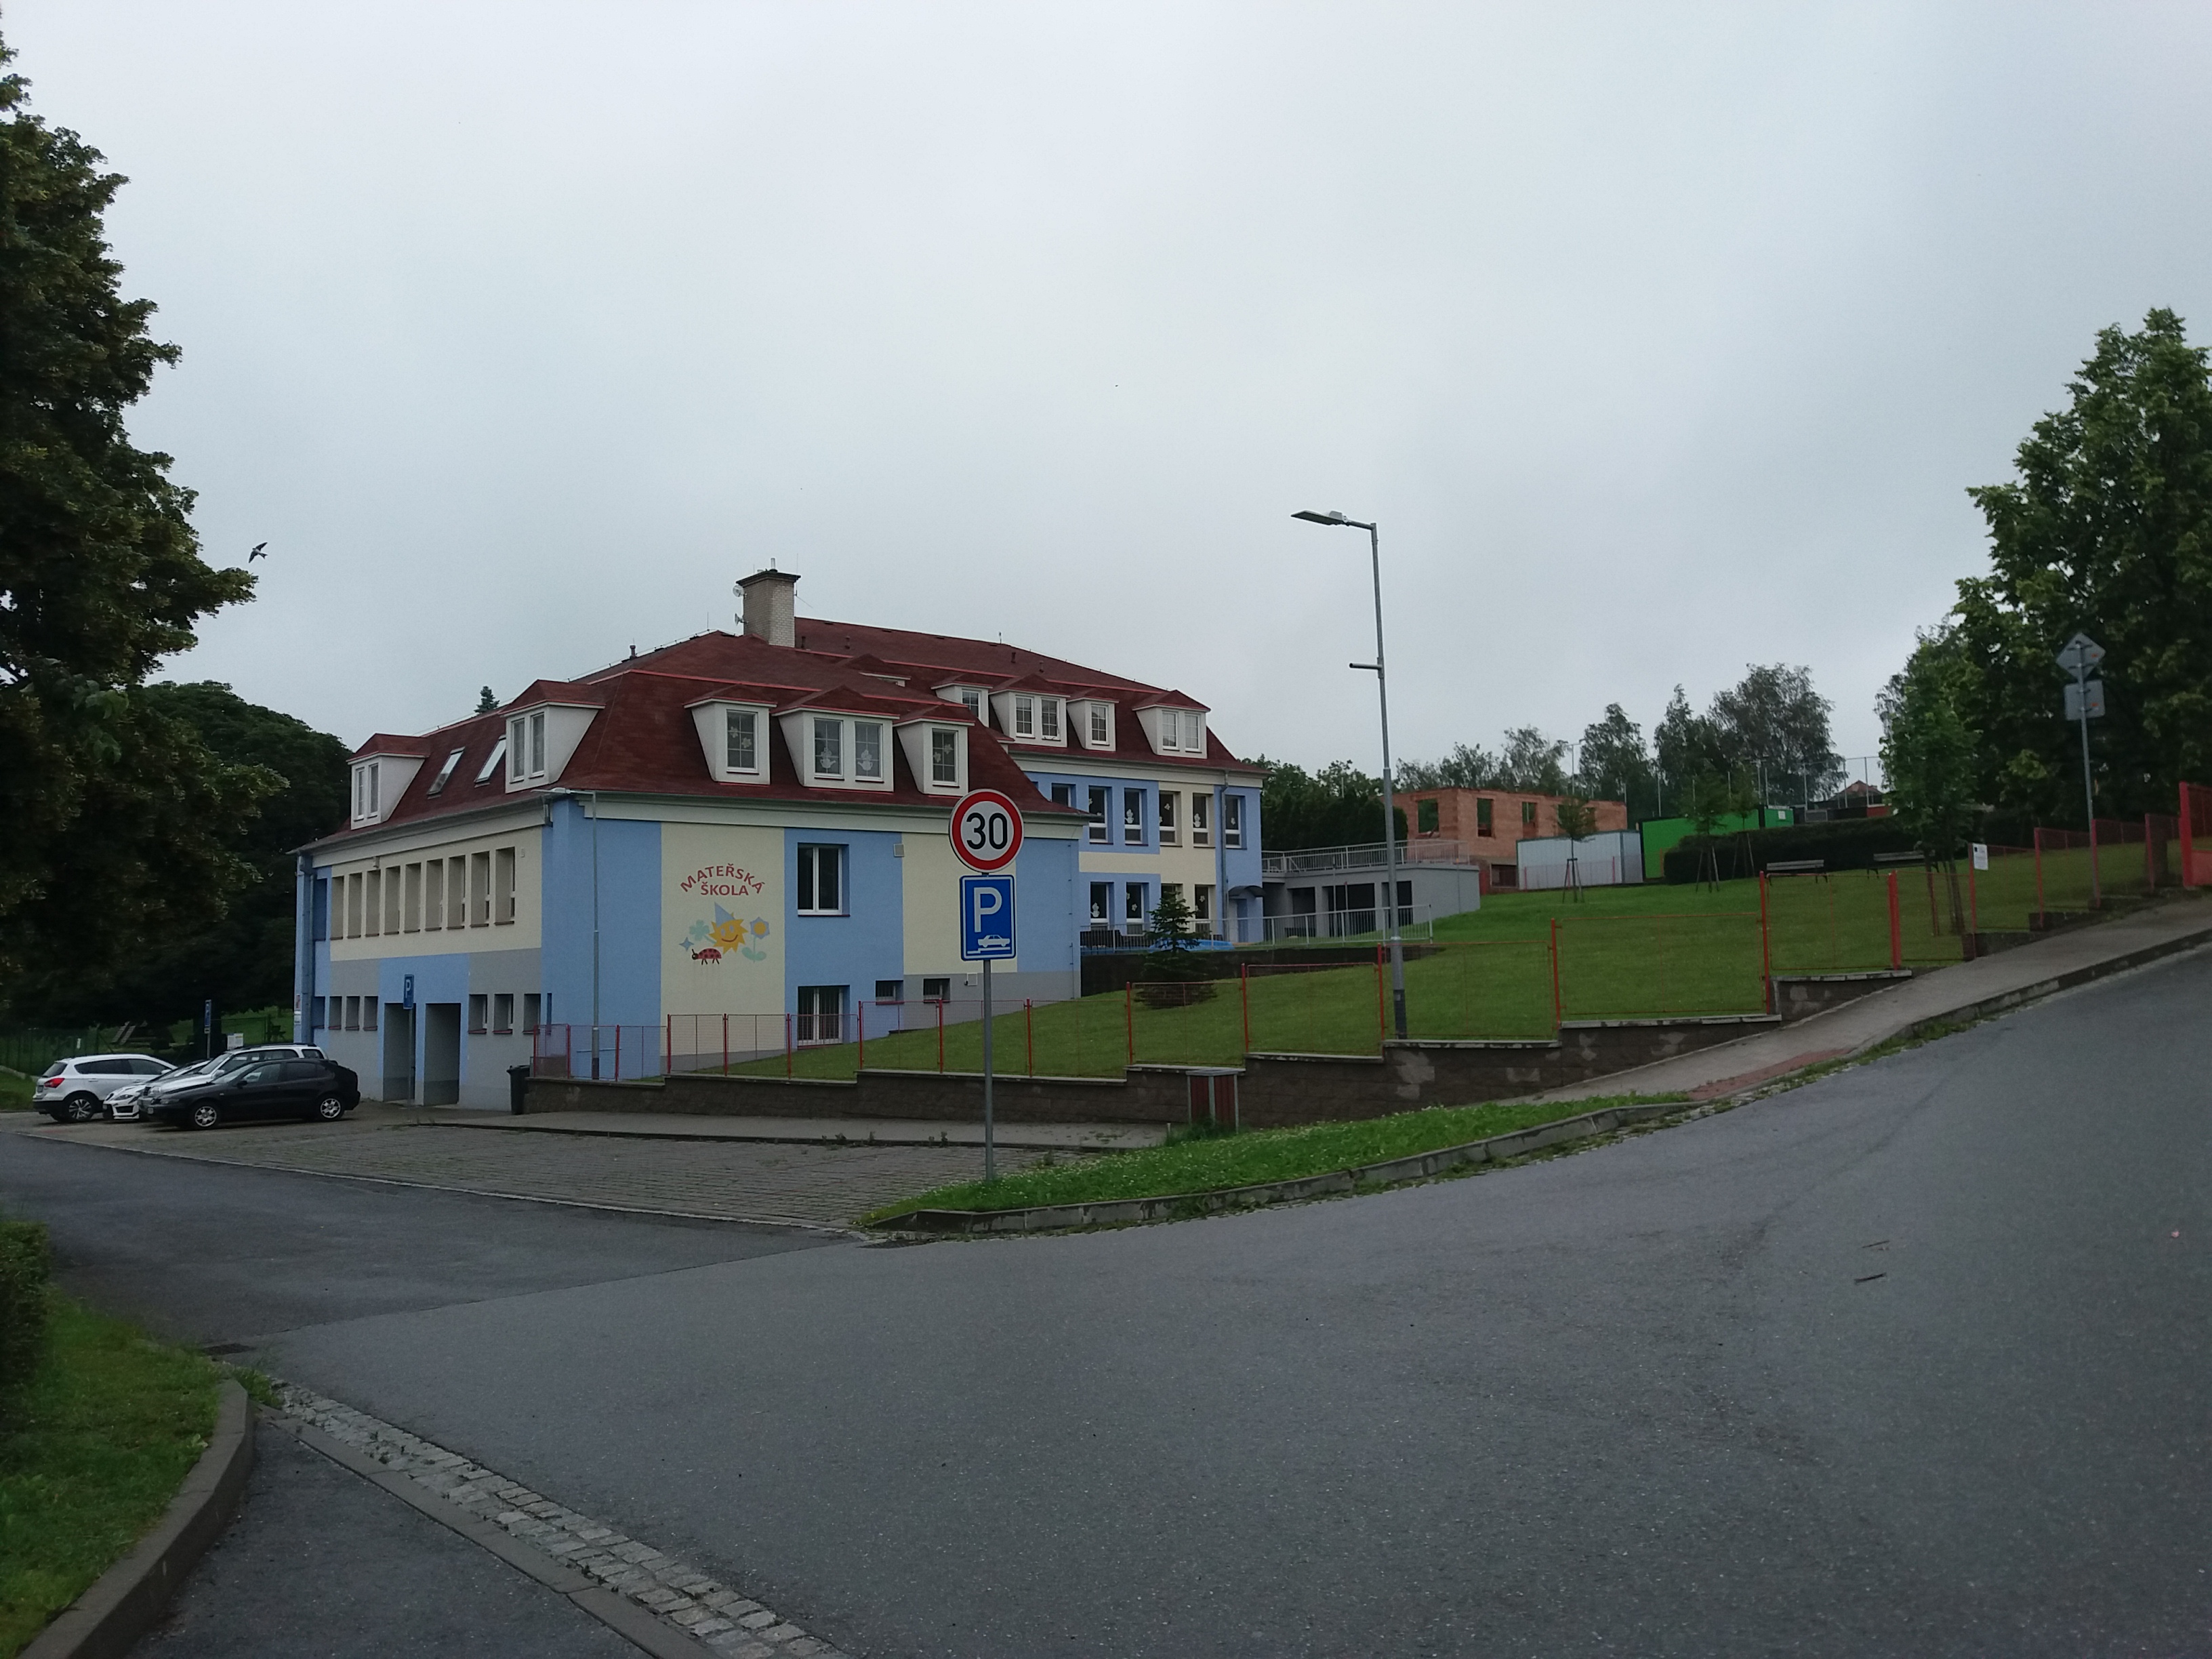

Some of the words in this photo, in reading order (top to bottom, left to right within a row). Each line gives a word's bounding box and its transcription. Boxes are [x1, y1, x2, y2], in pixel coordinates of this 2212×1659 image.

[966, 813, 1008, 850] 30
[680, 863, 765, 894] MATEŘSKÁ
[700, 881, 749, 896] ŠKOLA
[973, 886, 1002, 933] P
[405, 979, 411, 998] P
